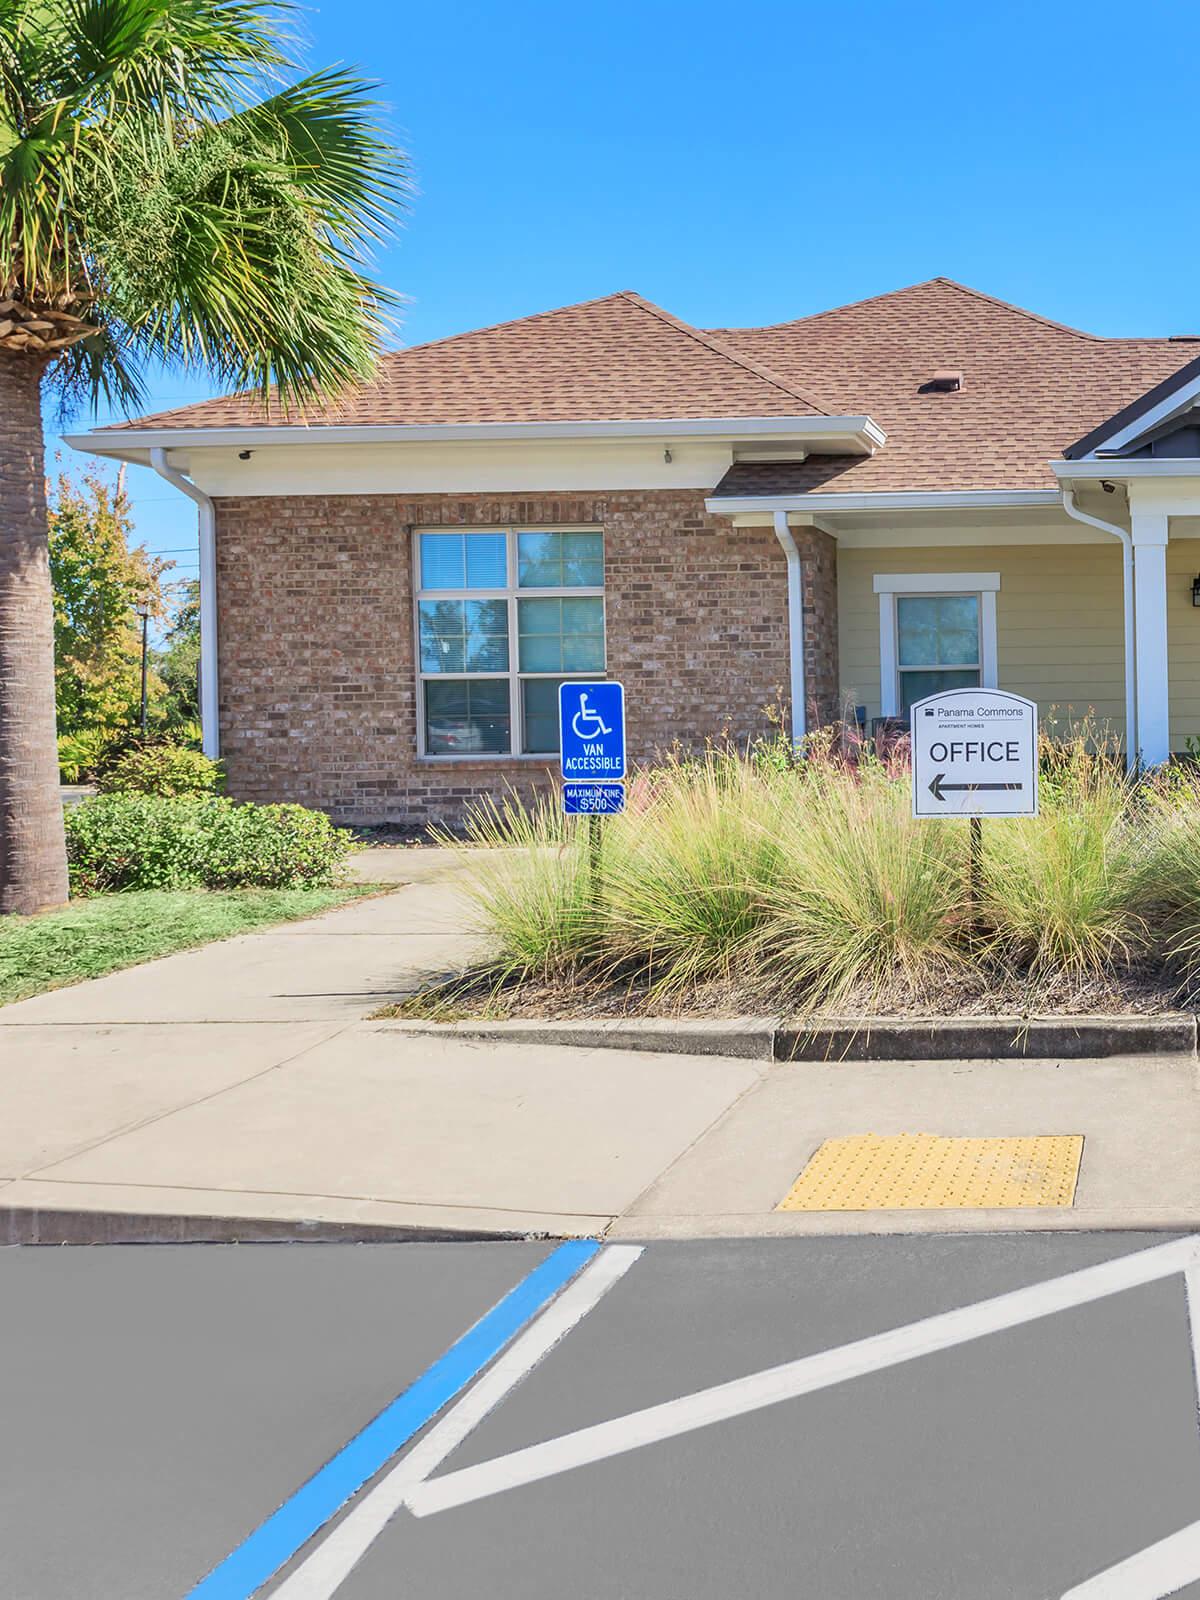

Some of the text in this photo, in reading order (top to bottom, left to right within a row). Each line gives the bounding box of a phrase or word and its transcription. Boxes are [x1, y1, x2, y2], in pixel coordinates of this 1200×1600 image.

[937, 707, 1024, 717] Panama Commons
[582, 743, 604, 756] VAN
[929, 741, 1020, 763] OFFICE
[565, 757, 622, 770] ACCESSIBLE
[567, 788, 602, 799] MAXIMUM
[580, 797, 607, 810] $500
